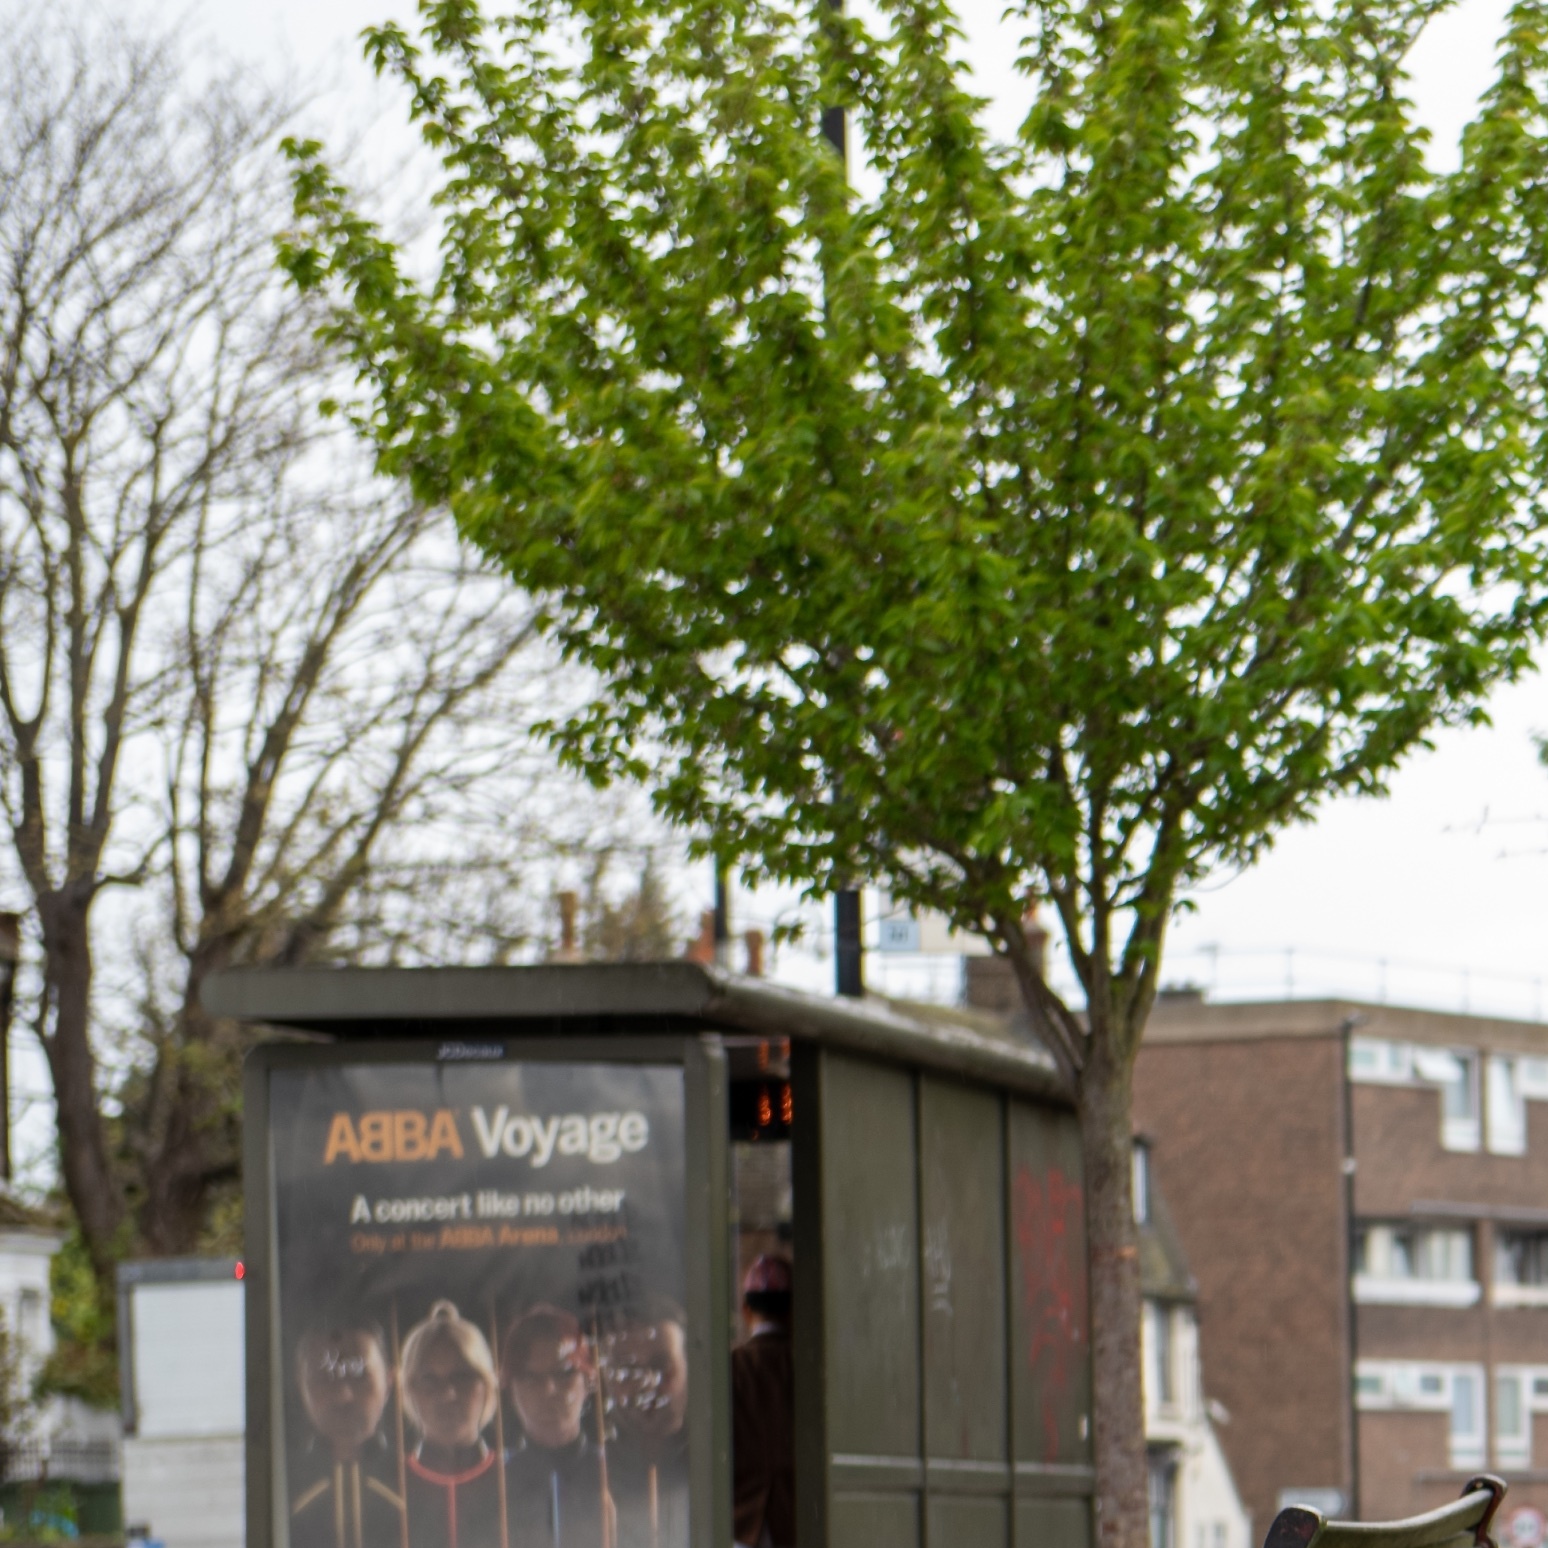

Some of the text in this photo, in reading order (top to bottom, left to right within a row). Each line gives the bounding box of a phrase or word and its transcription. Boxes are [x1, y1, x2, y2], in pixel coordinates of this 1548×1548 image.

[323, 1105, 650, 1168] ABBA Voyage
[351, 1186, 626, 1224] A concert like no other
